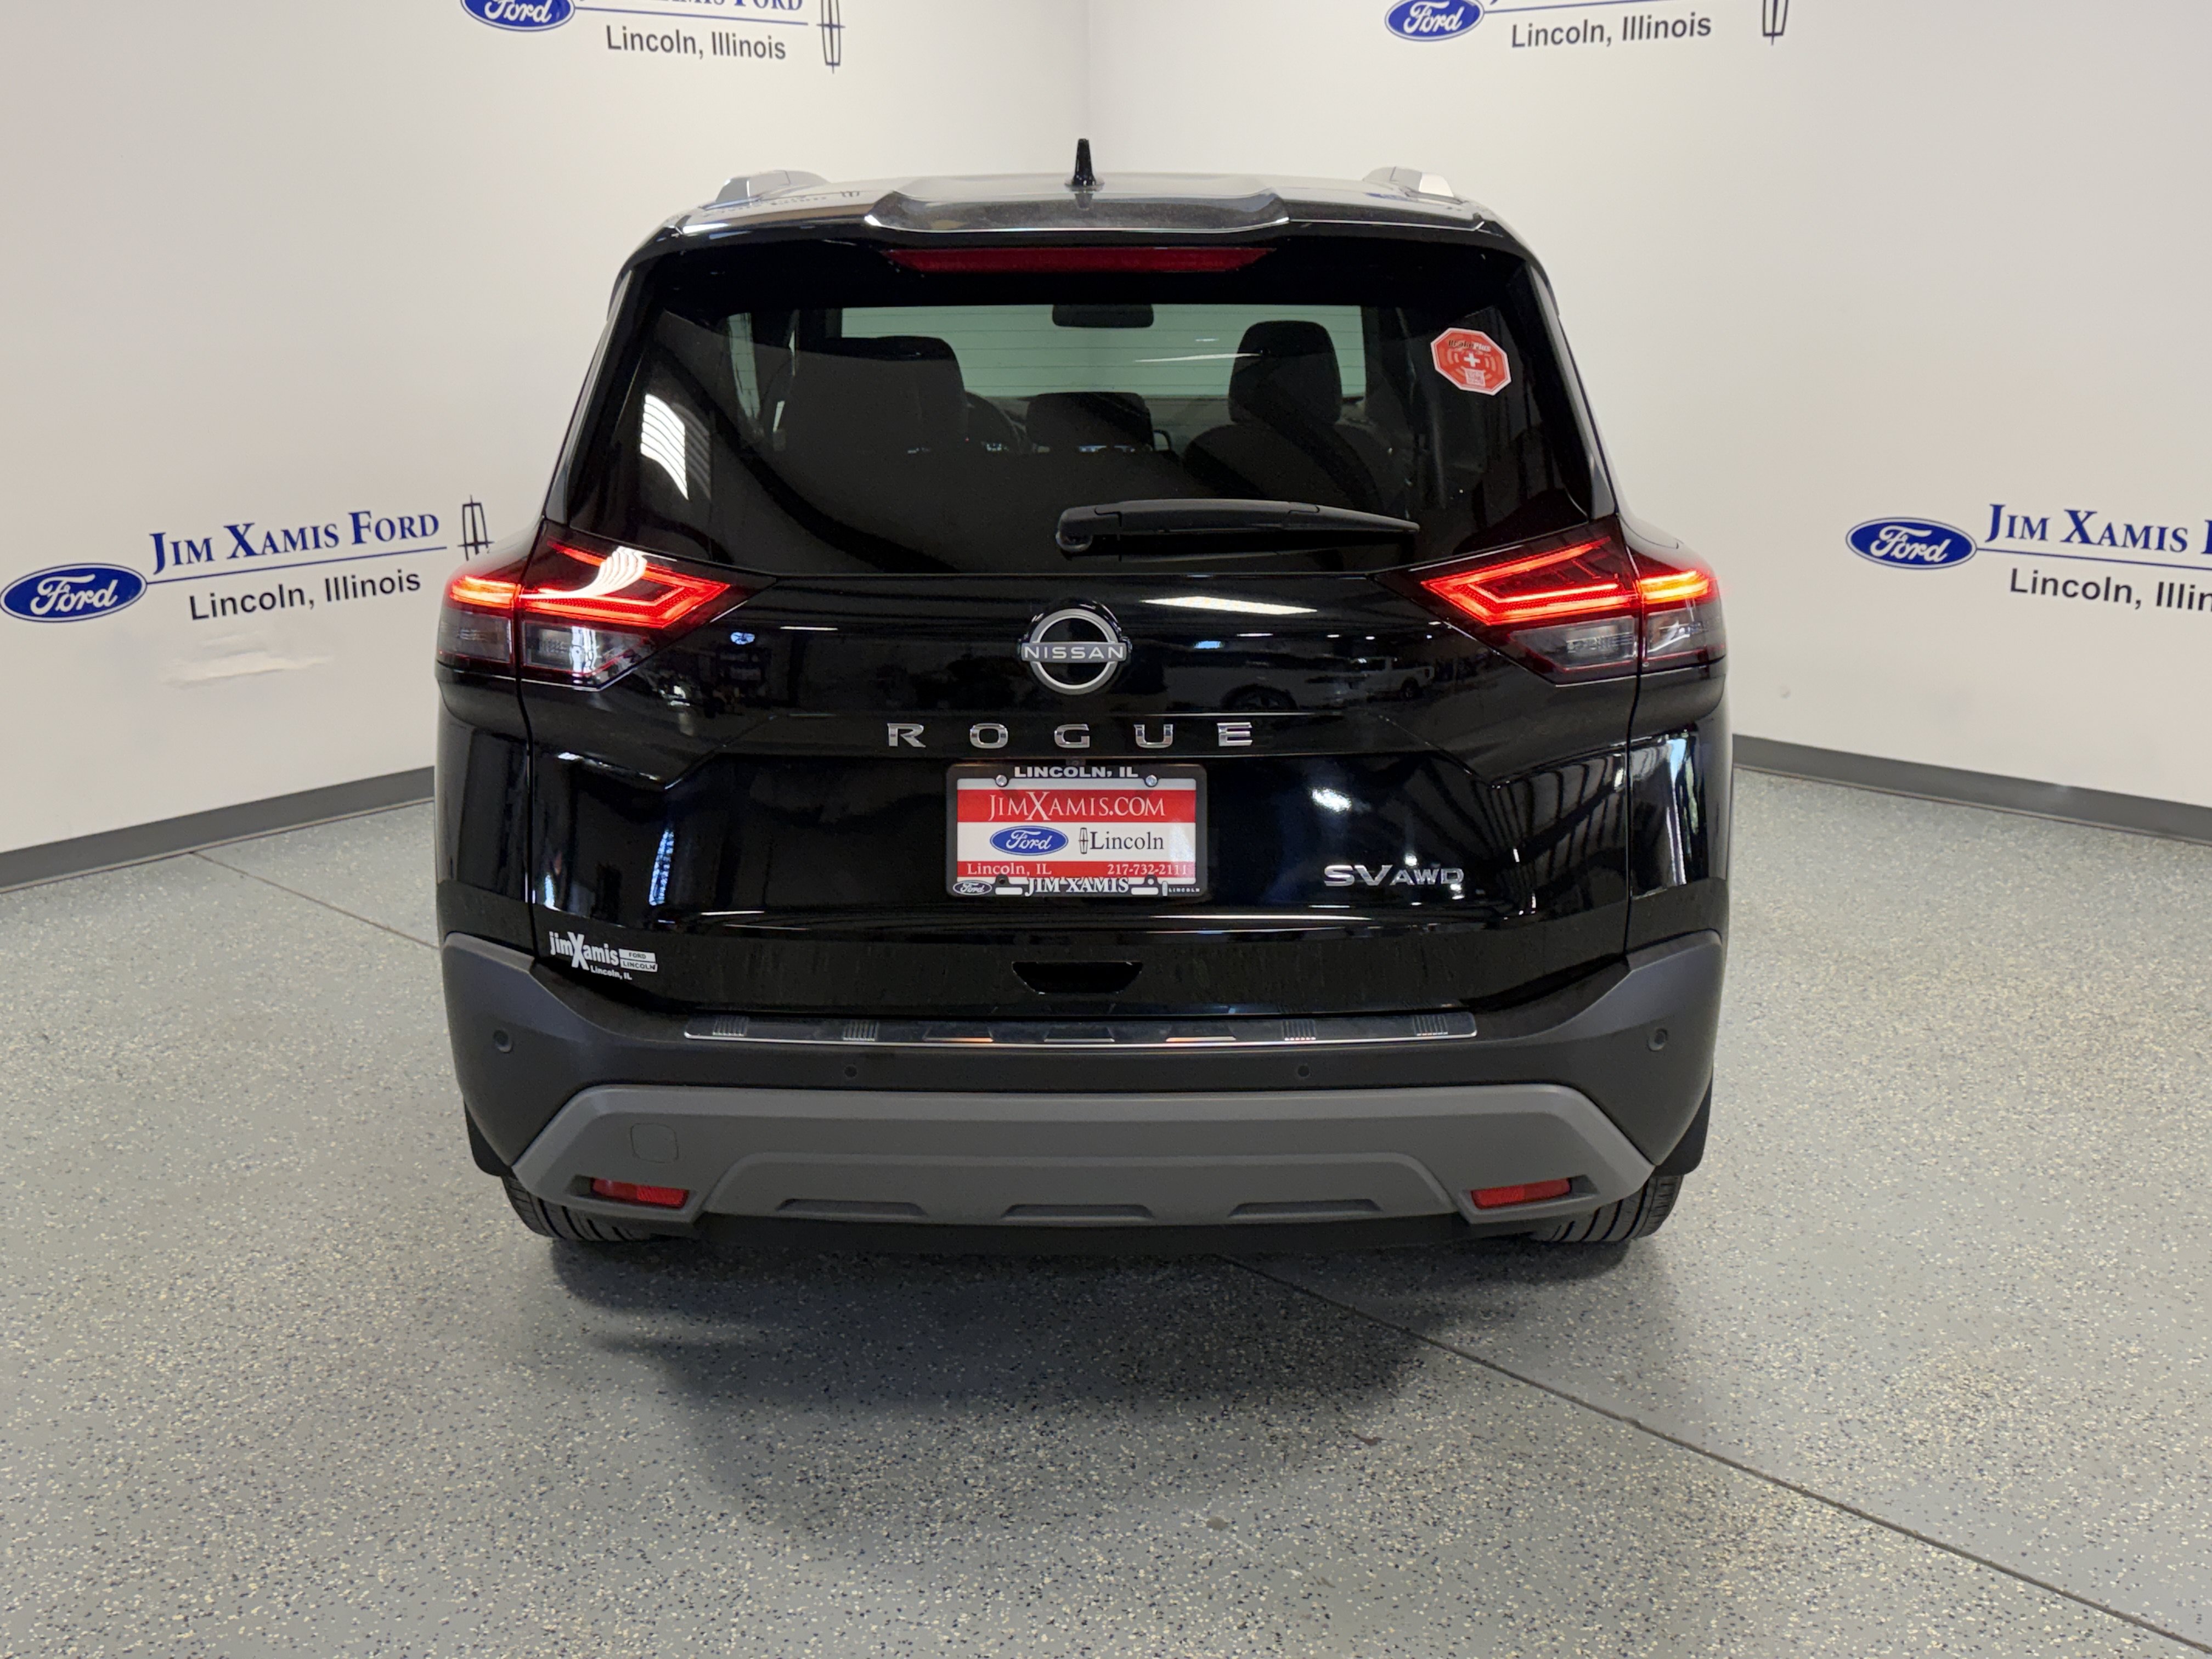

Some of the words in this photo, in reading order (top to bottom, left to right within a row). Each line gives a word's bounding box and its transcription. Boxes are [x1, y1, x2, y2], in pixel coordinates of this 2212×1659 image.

[1403, 1, 1465, 33] Ford
[1511, 18, 1613, 48] Lincoln,
[1622, 12, 1712, 42] Illinois
[605, 25, 704, 58] Lincoln,
[711, 31, 786, 60] Illinois
[1870, 524, 1948, 563] Ford
[30, 574, 119, 616] Ford
[189, 584, 316, 621] Lincoln,
[325, 569, 421, 602] Illinois
[2010, 567, 2142, 609] Lincoln,
[1024, 645, 1125, 659] NISSAN
[887, 721, 1254, 749] ROGUE
[1014, 766, 1113, 778] LINCOLN,
[1119, 766, 1139, 777] IL
[1006, 830, 1053, 850] Ford
[1090, 831, 1164, 850] Lincoln
[967, 863, 1031, 877] Lincoln,
[1036, 863, 1052, 875] IL
[1107, 864, 1187, 876] 217-732-2111
[960, 882, 985, 894] Ford
[1024, 877, 1061, 897] JIM
[1065, 877, 1129, 894] XAMIS
[590, 965, 622, 979] Lincoln,
[623, 972, 633, 980] IL
[623, 961, 656, 970] LINCOLN
